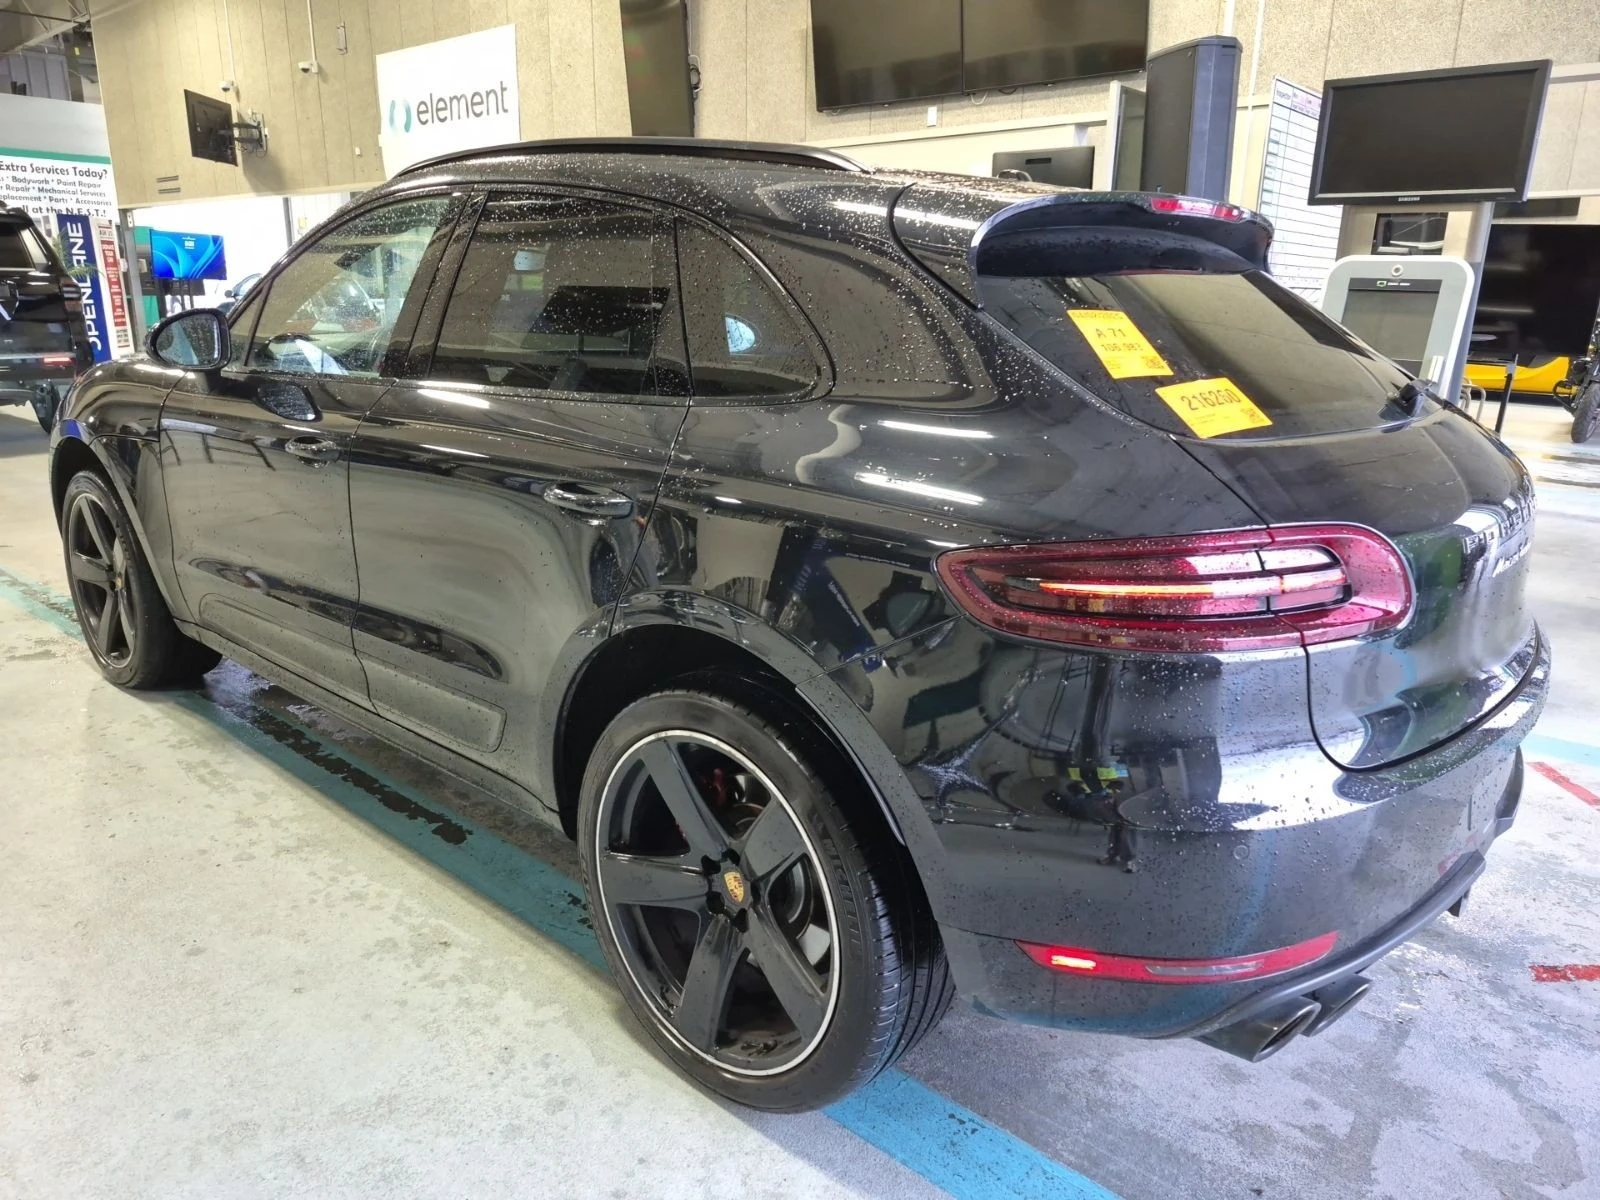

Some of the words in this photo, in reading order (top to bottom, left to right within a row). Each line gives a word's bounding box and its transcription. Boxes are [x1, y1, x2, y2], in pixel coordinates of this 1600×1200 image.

[416, 80, 509, 125] element
[0, 161, 27, 173] Extra
[30, 163, 70, 176] Services
[72, 166, 108, 180] Today?
[11, 176, 50, 185] Bodywork
[57, 179, 76, 187] Paint
[78, 180, 101, 189] Repair
[5, 184, 32, 192] Repair
[38, 187, 79, 195] Mechanical
[80, 190, 106, 198] Services
[76, 198, 112, 206] Accessories
[46, 207, 63, 215] the
[1107, 327, 1126, 338] 71
